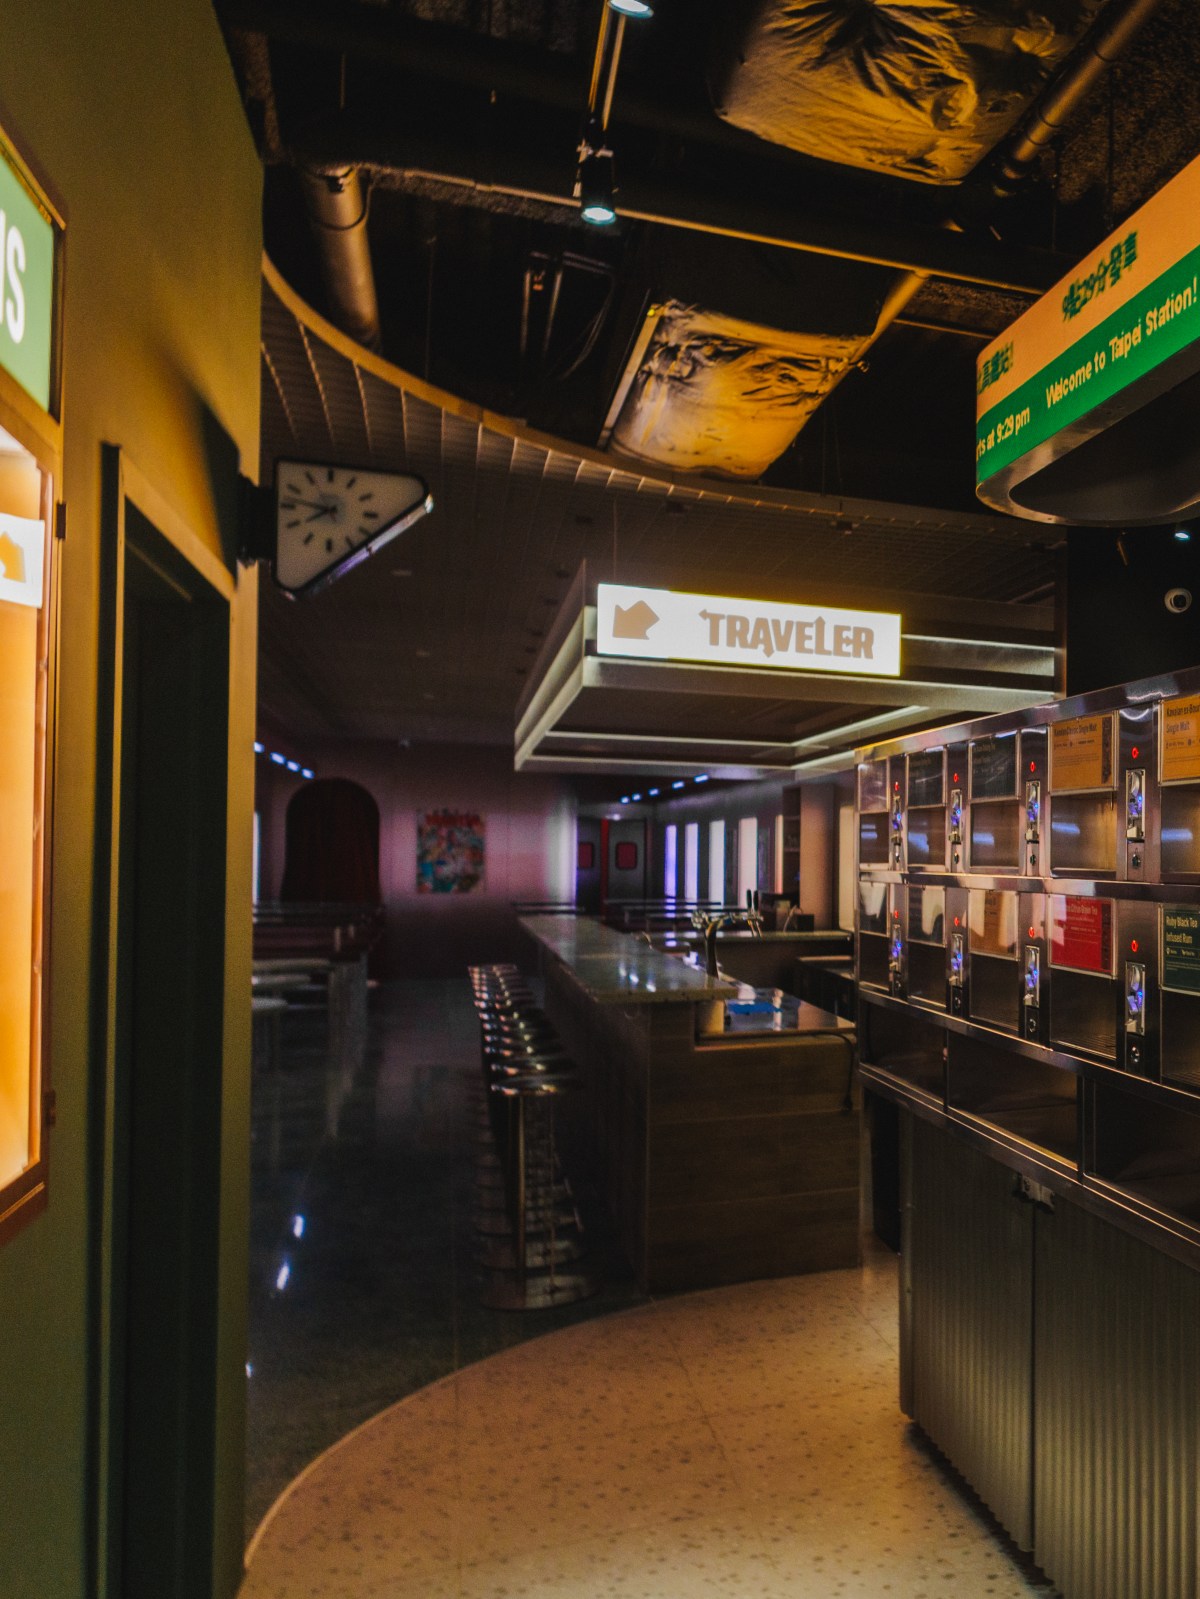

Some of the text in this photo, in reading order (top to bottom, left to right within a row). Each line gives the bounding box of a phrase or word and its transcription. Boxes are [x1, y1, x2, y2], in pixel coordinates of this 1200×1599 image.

[1045, 277, 1198, 408] Welcome to Taipei Station!
[987, 429, 995, 451] at
[997, 418, 1014, 443] 9:29
[1015, 406, 1030, 436] pm
[699, 609, 874, 659] TRAVELER
[1189, 917, 1198, 928] Tea
